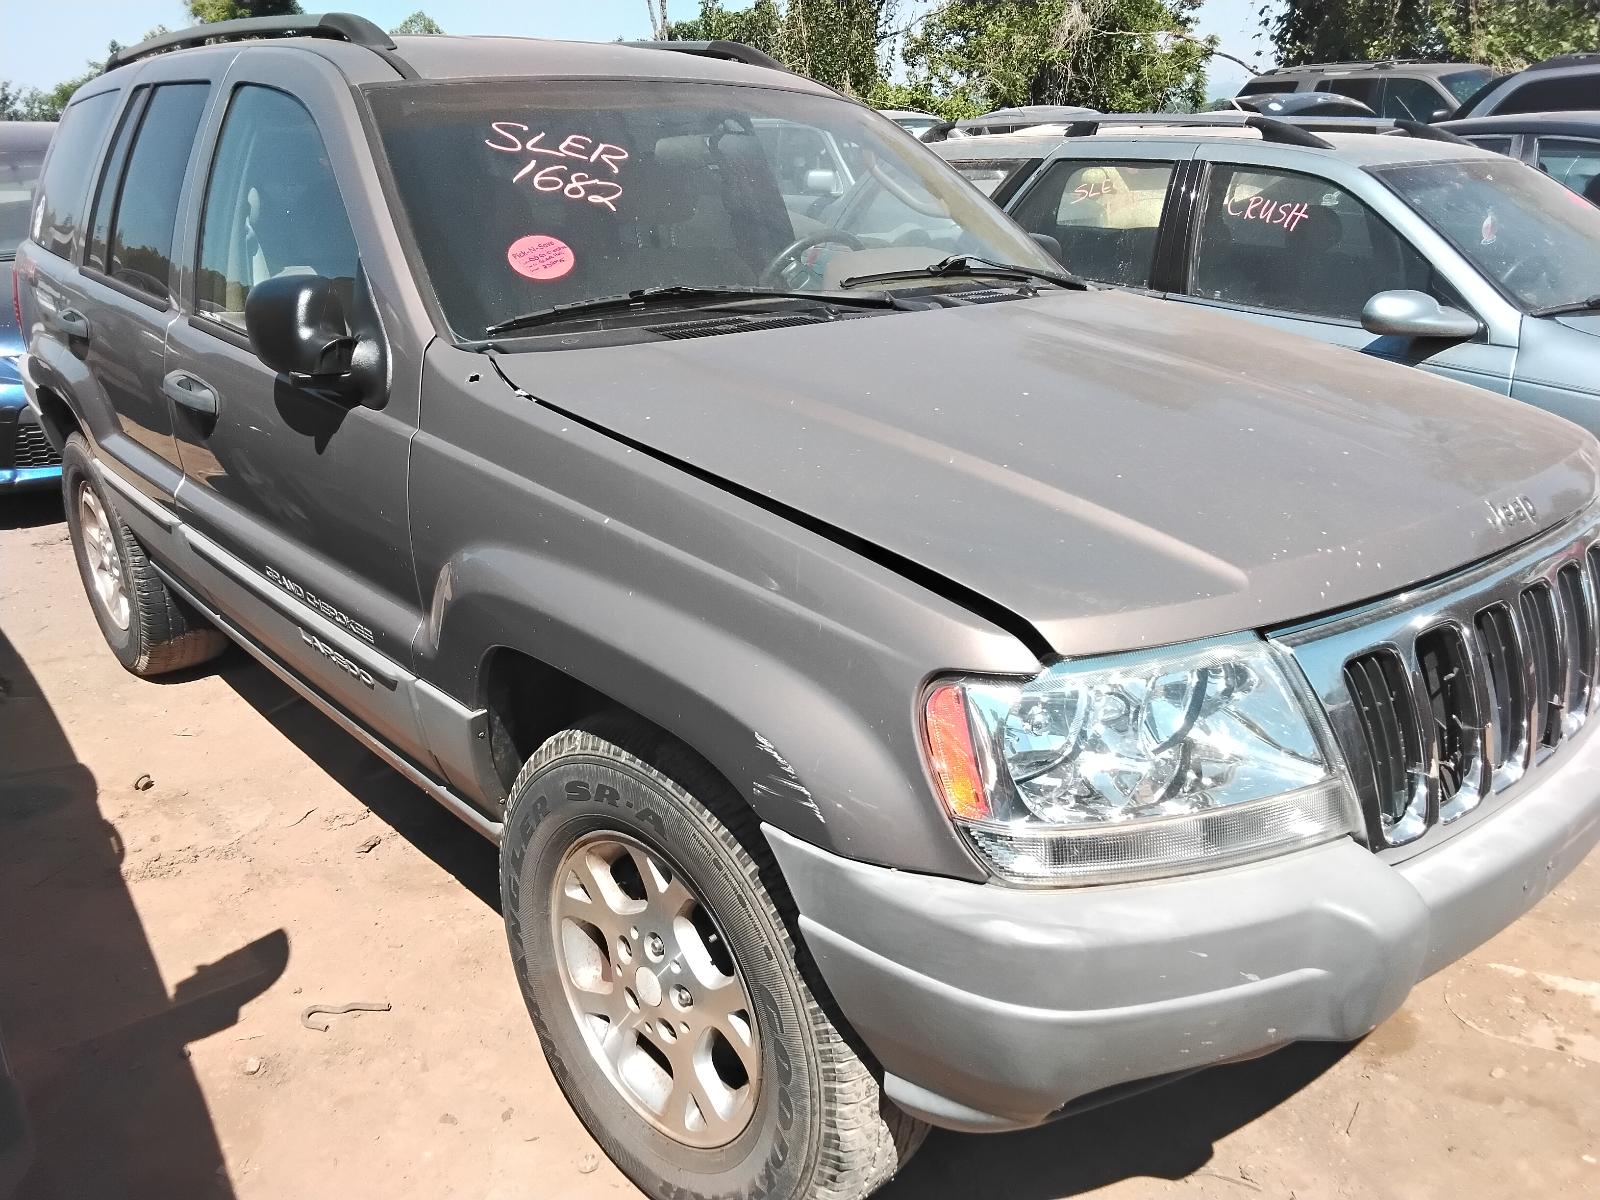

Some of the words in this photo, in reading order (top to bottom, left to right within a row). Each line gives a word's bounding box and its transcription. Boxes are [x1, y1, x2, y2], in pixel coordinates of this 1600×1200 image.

[484, 121, 629, 174] SLER
[512, 159, 623, 212] 1682
[1227, 194, 1309, 232] CRUSH
[265, 565, 305, 599] GRAND
[306, 591, 375, 644] CHEROKEE
[298, 626, 375, 690] LAREDO
